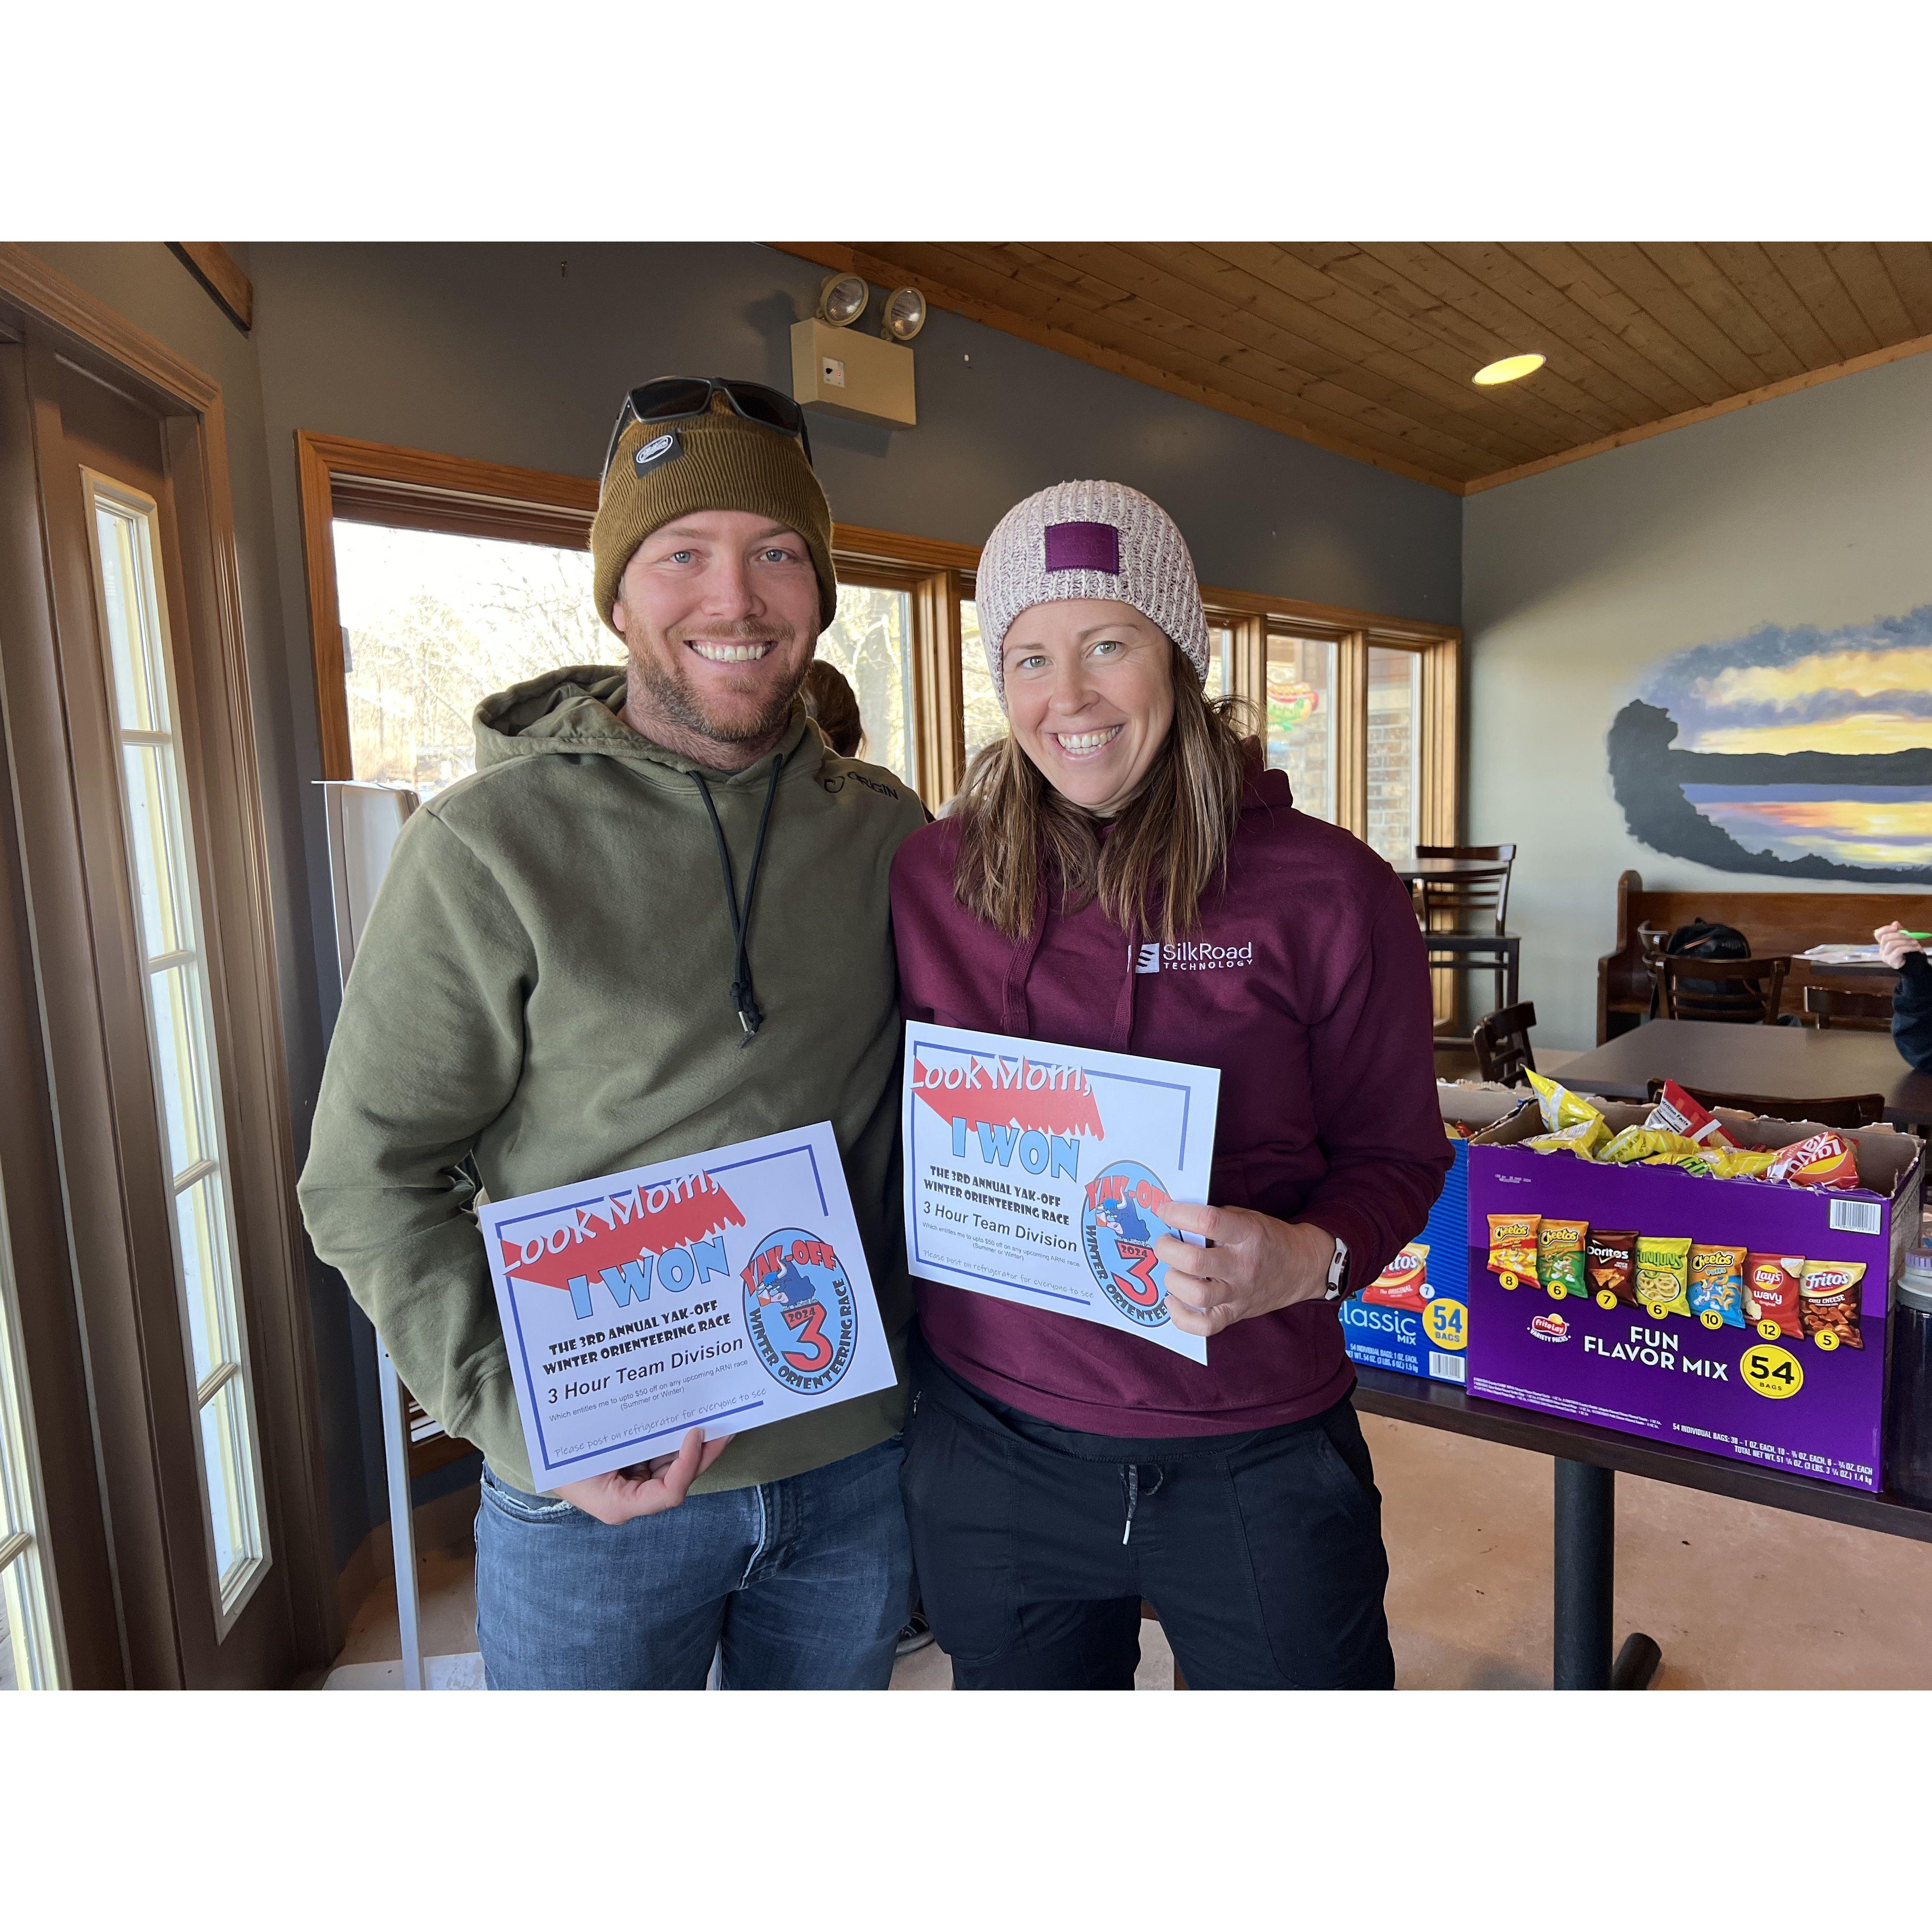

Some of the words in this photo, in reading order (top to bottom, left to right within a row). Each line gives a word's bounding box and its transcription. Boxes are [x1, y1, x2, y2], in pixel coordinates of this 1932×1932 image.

[1163, 942, 1252, 961] SilkRoad
[1163, 959, 1253, 970] TECHNOLOGY
[910, 1054, 983, 1089] Look
[992, 1054, 1092, 1096] Mom,
[952, 1116, 966, 1158] I
[975, 1120, 1080, 1183] WON
[930, 1165, 949, 1179] THE
[952, 1171, 970, 1184] 3RD
[972, 1176, 1012, 1195] ANNUAL
[1014, 1186, 1061, 1207] YAK-OFF
[1084, 1175, 1173, 1218] YAK-OF
[924, 1179, 962, 1198] WINTER
[964, 1189, 1039, 1218] ORIENTEERING
[1042, 1208, 1070, 1226] RACE
[497, 1208, 596, 1272] Look
[603, 1170, 720, 1230] Mom,
[923, 1201, 931, 1214] 3
[935, 1204, 969, 1224] Hour
[973, 1213, 1010, 1235] Team
[1015, 1225, 1077, 1252] Division
[1495, 1224, 1529, 1240] Cheetos
[922, 1221, 939, 1231] Which
[939, 1226, 956, 1236] entitles
[973, 1236, 984, 1244] upto
[985, 1238, 995, 1247] $50
[1023, 1249, 1049, 1261] upcoming
[1050, 1255, 1066, 1264] ARNI
[1541, 1229, 1578, 1245] Cheetos
[973, 1242, 996, 1253] (Summer
[1004, 1250, 1024, 1261] Winter)
[1086, 1225, 1108, 1280] WINTER
[1121, 1245, 1148, 1258] 2024
[1587, 1246, 1629, 1259] Doritos
[1692, 1253, 1733, 1271] Cheetos
[567, 1274, 593, 1320] I
[598, 1236, 730, 1308] WON
[740, 1240, 837, 1297] YAK-OFF
[923, 1250, 945, 1261] Please
[946, 1256, 962, 1266] post
[974, 1263, 1017, 1279] refrigerator
[1020, 1274, 1032, 1283] for
[1034, 1278, 1068, 1293] everyone
[1070, 1287, 1079, 1295] to
[1081, 1289, 1094, 1299] see
[1110, 1239, 1159, 1307] 3
[1506, 1276, 1512, 1285] 8
[1806, 1272, 1849, 1290] Fritos
[1554, 1286, 1561, 1295] 6
[1603, 1295, 1610, 1304] 7
[1754, 1290, 1782, 1305] wavy
[1822, 1294, 1845, 1304] CHEESE
[788, 1307, 816, 1322] 2024
[1339, 1301, 1416, 1336] lassic
[1433, 1305, 1462, 1334] 54
[1654, 1305, 1662, 1314] 6
[1705, 1314, 1718, 1324] 10
[549, 1338, 577, 1356] THE
[579, 1331, 606, 1347] 3RD
[609, 1316, 660, 1340] ANNUAL
[661, 1300, 718, 1324] YAK-OFF
[749, 1307, 779, 1367] WINTER
[778, 1319, 852, 1389] ORIENTEERING
[833, 1278, 851, 1317] RACE
[781, 1301, 834, 1372] 3
[1397, 1334, 1416, 1345] MIX
[1435, 1332, 1460, 1342] BAGS
[1530, 1329, 1552, 1342] VARIETY
[1630, 1326, 1679, 1351] FUN
[1763, 1324, 1776, 1335] 12
[1823, 1335, 1831, 1346] 5
[542, 1351, 598, 1375] WINTER
[600, 1323, 696, 1359] ORIENTEERING
[698, 1313, 731, 1331] RACE
[548, 1388, 557, 1404] 3
[564, 1375, 610, 1400] Hour
[616, 1360, 665, 1384] Team
[671, 1337, 743, 1369] Division
[1584, 1336, 1674, 1370] FLAVOR
[1683, 1356, 1728, 1381] MIX
[1749, 1355, 1794, 1381] 54
[549, 1411, 572, 1422] Which
[573, 1403, 597, 1415] entitles
[619, 1392, 634, 1405] upto
[635, 1387, 648, 1398] $50
[649, 1384, 659, 1394] off
[659, 1383, 668, 1392] on
[669, 1379, 681, 1390] any
[682, 1369, 714, 1388] upcoming
[715, 1363, 732, 1375] ARNI
[734, 1359, 748, 1369] race
[621, 1396, 652, 1412] (Summer
[661, 1386, 685, 1400] Winter)
[1760, 1382, 1782, 1391] BAGS
[554, 1442, 585, 1458] Please
[587, 1435, 609, 1449] post
[611, 1430, 621, 1440] on
[623, 1413, 680, 1436] refrigerator
[682, 1408, 696, 1419] for
[698, 1397, 737, 1416] everyone
[739, 1392, 750, 1401] to
[752, 1388, 767, 1399] see
[1673, 1423, 1680, 1431] 54
[1681, 1425, 1712, 1438] INDIVIDUAL
[1713, 1432, 1730, 1443] BAGS:
[1760, 1443, 1776, 1454] EACH.
[1778, 1448, 1785, 1456] 10
[1799, 1452, 1808, 1461] OZ.
[1809, 1454, 1826, 1465] EACH.
[1846, 1463, 1855, 1472] OZ.
[1857, 1465, 1873, 1475] EACH
[1735, 1446, 1751, 1456] TOTAL
[1753, 1450, 1763, 1459] NET
[1765, 1452, 1775, 1461] WT.
[1776, 1455, 1783, 1463] 51
[1794, 1460, 1803, 1468] OZ.
[1812, 1463, 1825, 1473] LBS.
[1840, 1470, 1852, 1481] OZ.)
[1854, 1473, 1863, 1482] 1.4
[1865, 1476, 1873, 1485] kg
